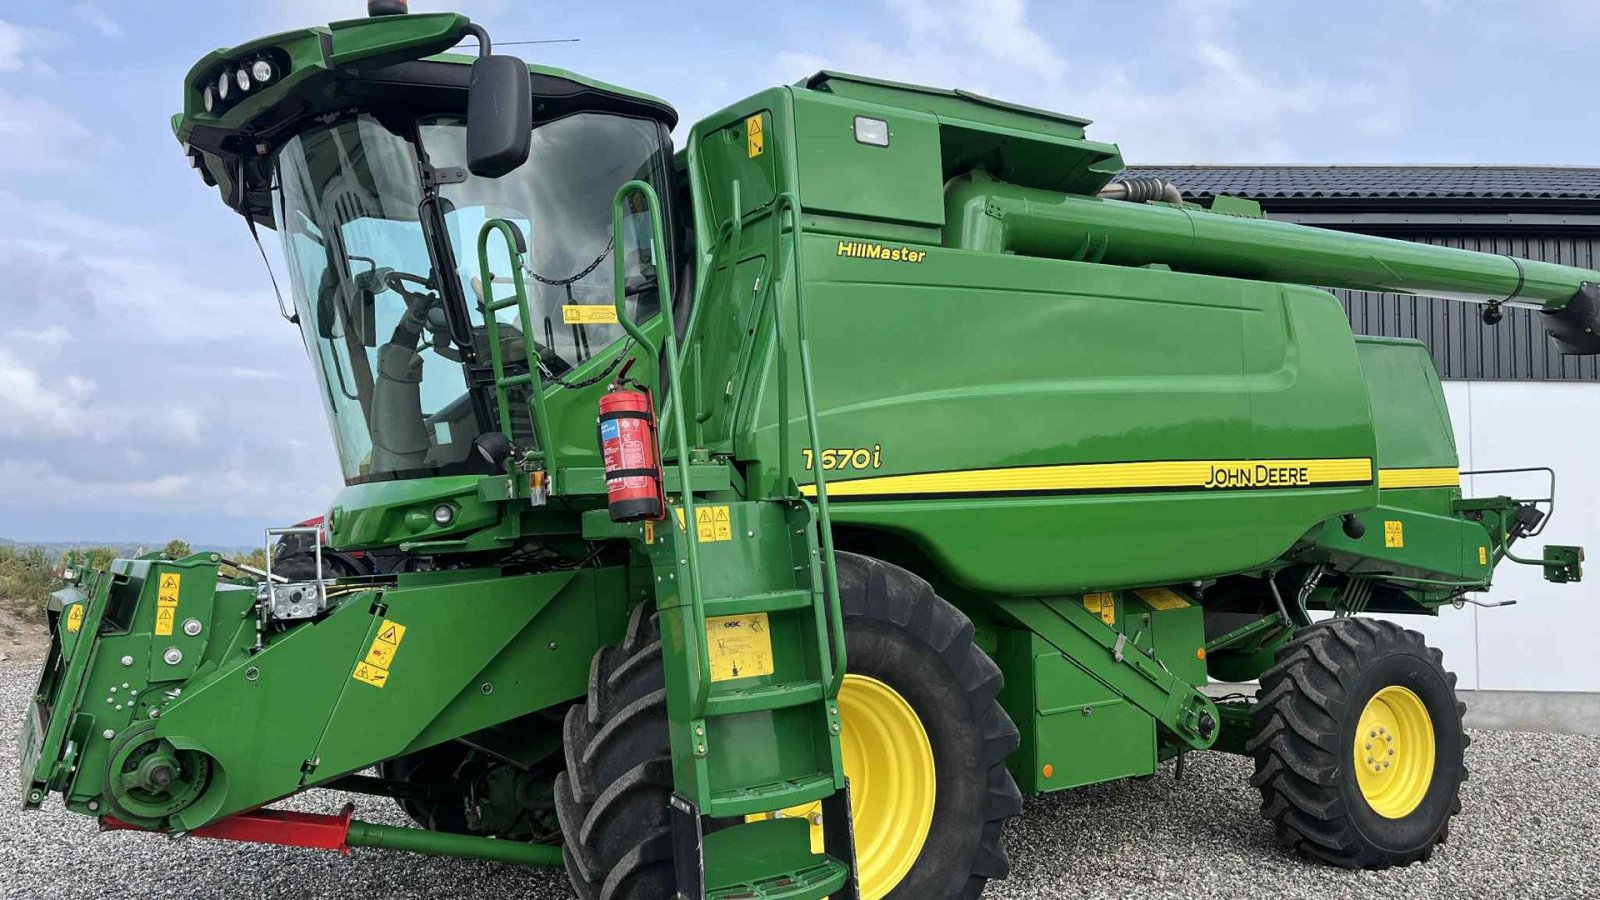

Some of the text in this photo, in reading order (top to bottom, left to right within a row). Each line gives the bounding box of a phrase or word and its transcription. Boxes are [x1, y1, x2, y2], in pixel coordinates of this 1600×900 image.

[837, 241, 926, 262] HillMaster
[1204, 464, 1309, 486] JOHN DEERE
